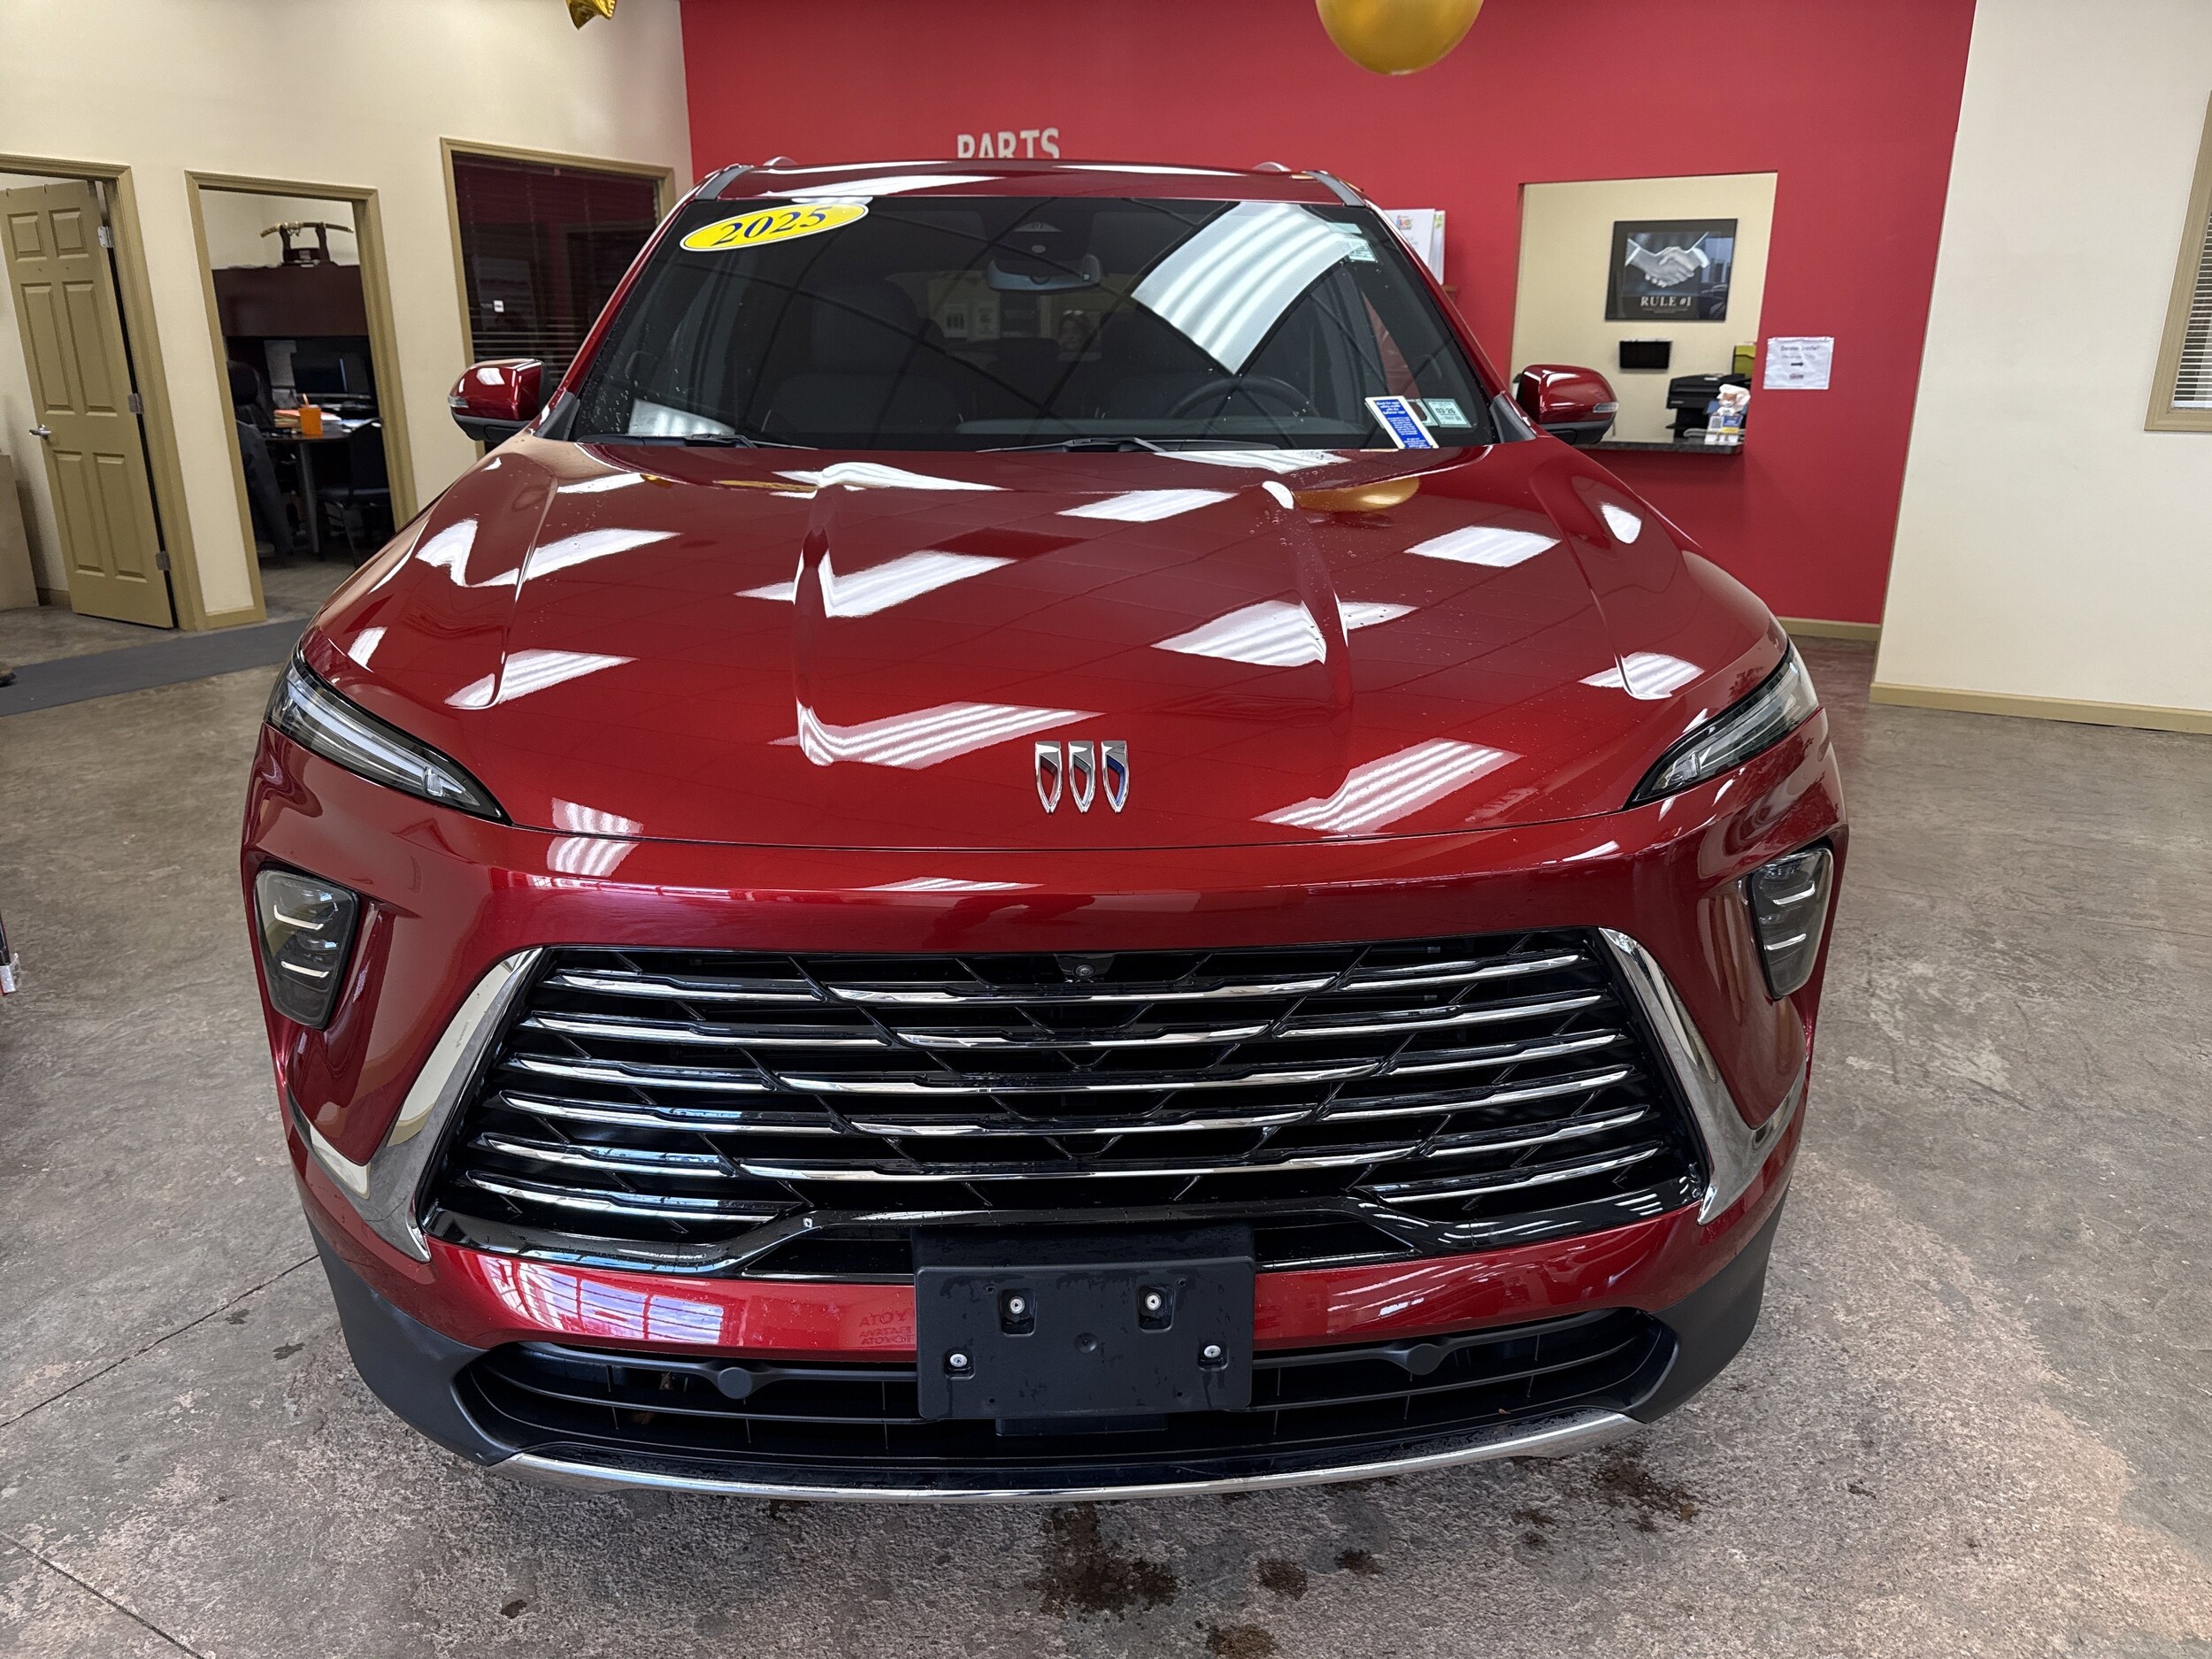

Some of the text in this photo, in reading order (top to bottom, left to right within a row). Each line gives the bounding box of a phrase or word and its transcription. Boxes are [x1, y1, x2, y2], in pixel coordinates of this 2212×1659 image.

[957, 127, 1060, 158] PARTS
[710, 205, 833, 247] 2025
[1640, 296, 1692, 307] RULE #1
